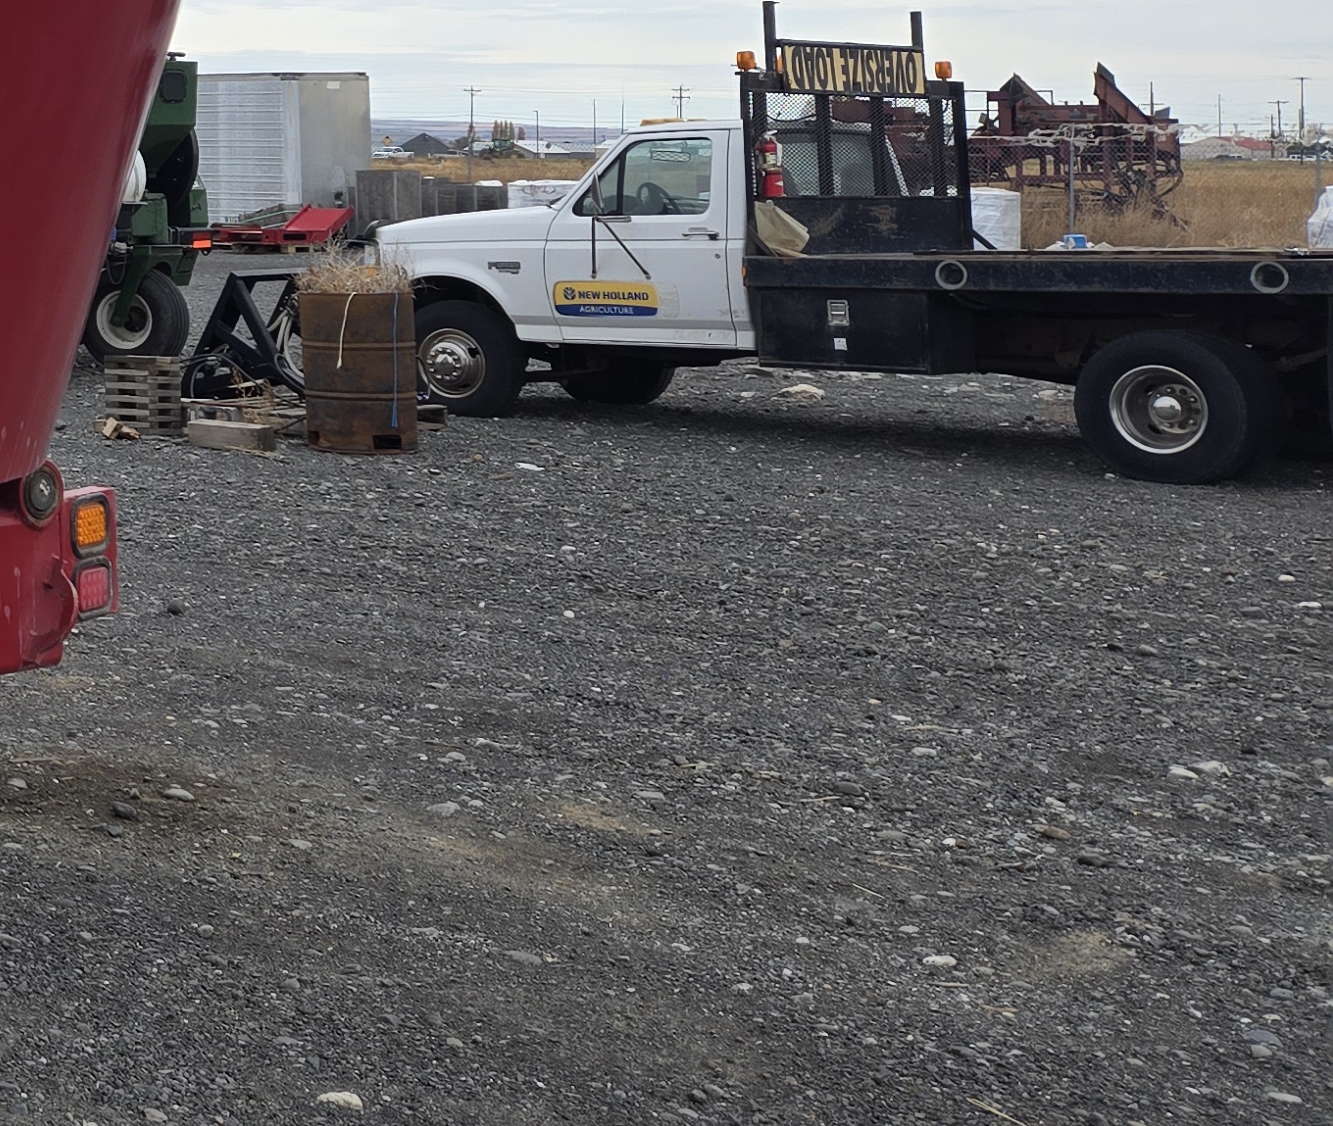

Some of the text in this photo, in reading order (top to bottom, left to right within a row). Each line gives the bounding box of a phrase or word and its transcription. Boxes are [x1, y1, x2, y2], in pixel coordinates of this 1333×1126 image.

[790, 45, 917, 94] OVERSIZE LOAD
[577, 290, 649, 301] NEW HOLLAND
[579, 305, 634, 315] AGRICULTURE
